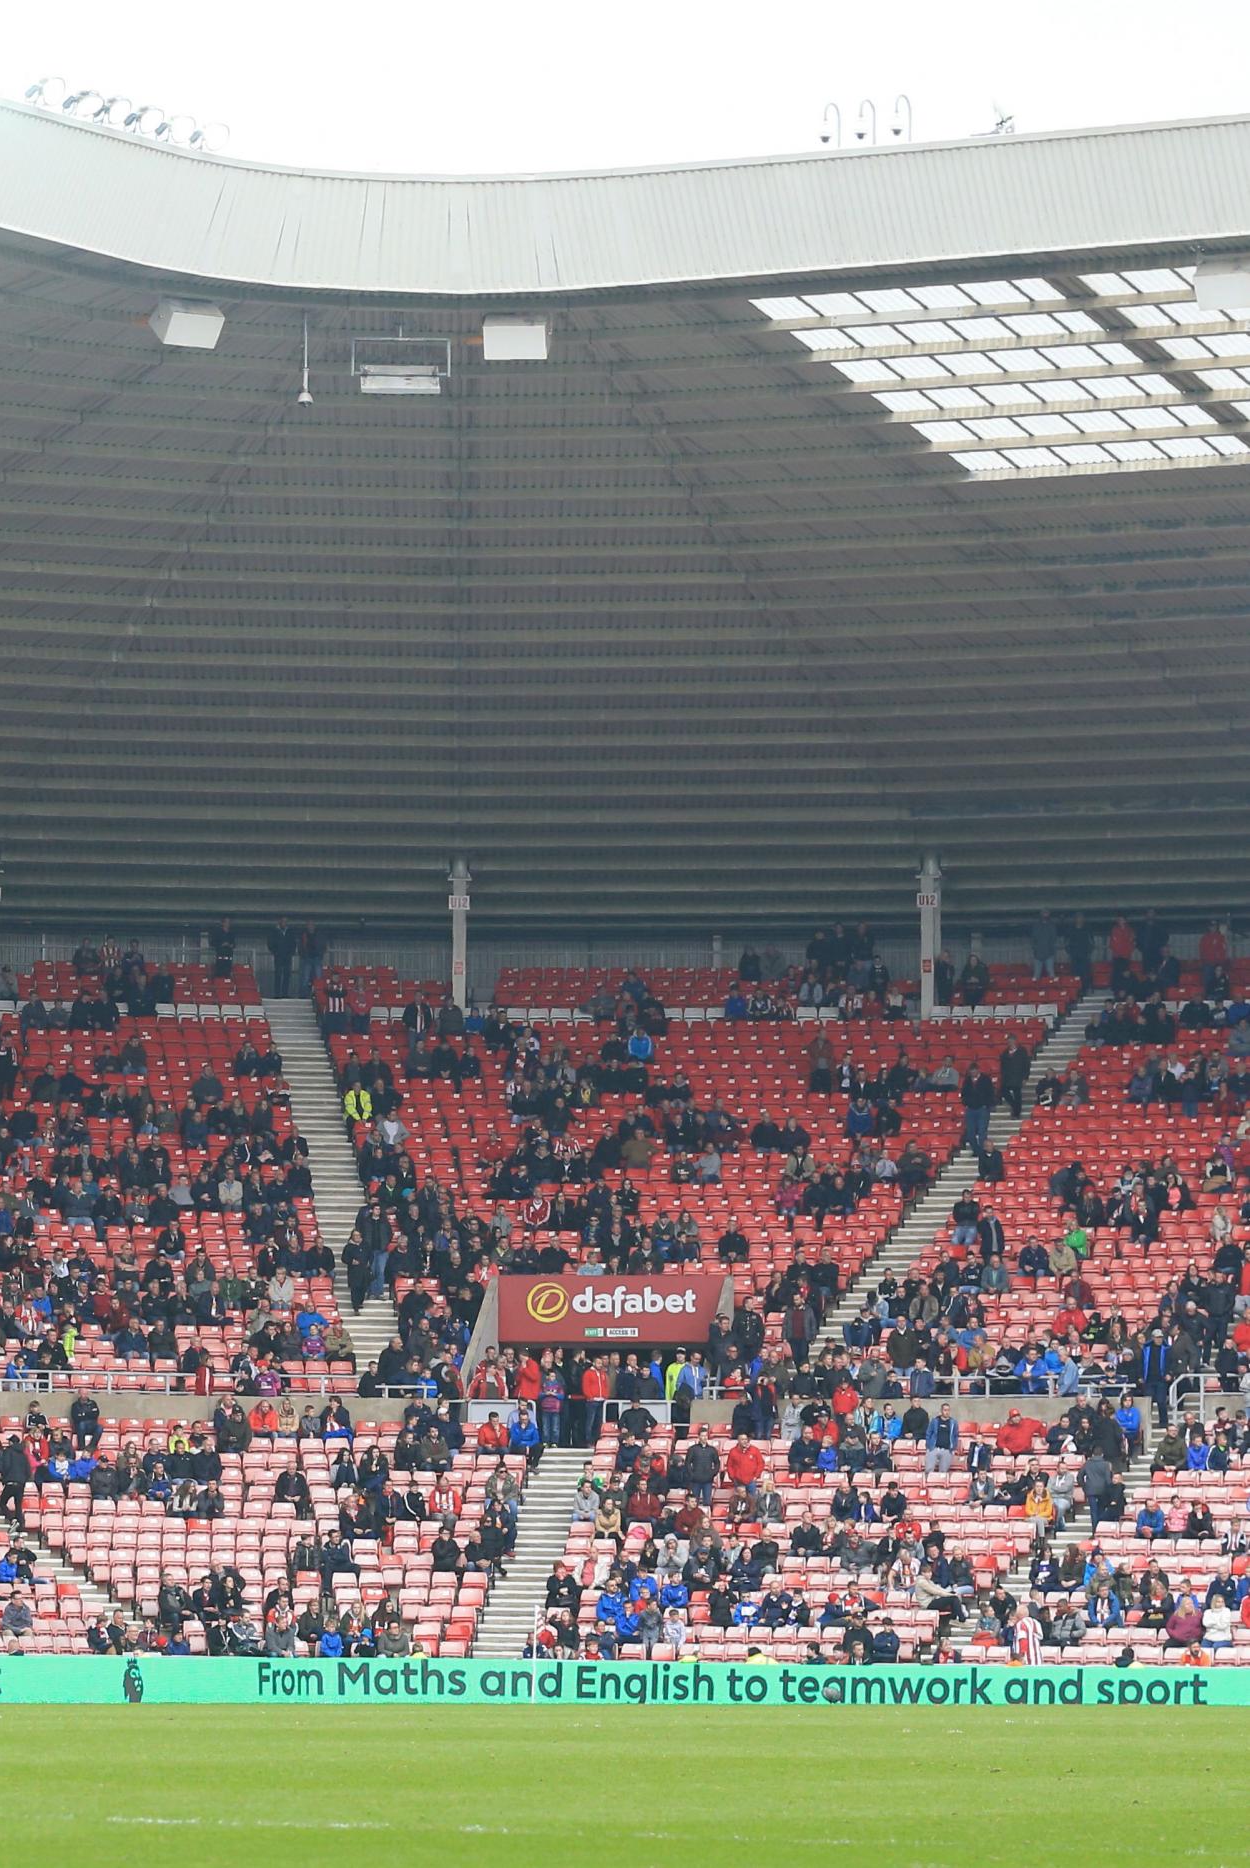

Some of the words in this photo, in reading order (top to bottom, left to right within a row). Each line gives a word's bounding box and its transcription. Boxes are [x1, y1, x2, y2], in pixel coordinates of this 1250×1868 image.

[450, 897, 468, 908] U12
[919, 895, 936, 906] U12
[572, 1285, 696, 1319] dafabet
[257, 1662, 324, 1696] From
[337, 1659, 467, 1696] Maths
[480, 1661, 563, 1698] and
[576, 1664, 714, 1703] English
[727, 1669, 768, 1702] to
[780, 1668, 992, 1704] teamwork
[1005, 1668, 1083, 1704] and
[1098, 1673, 1208, 1704] sport
